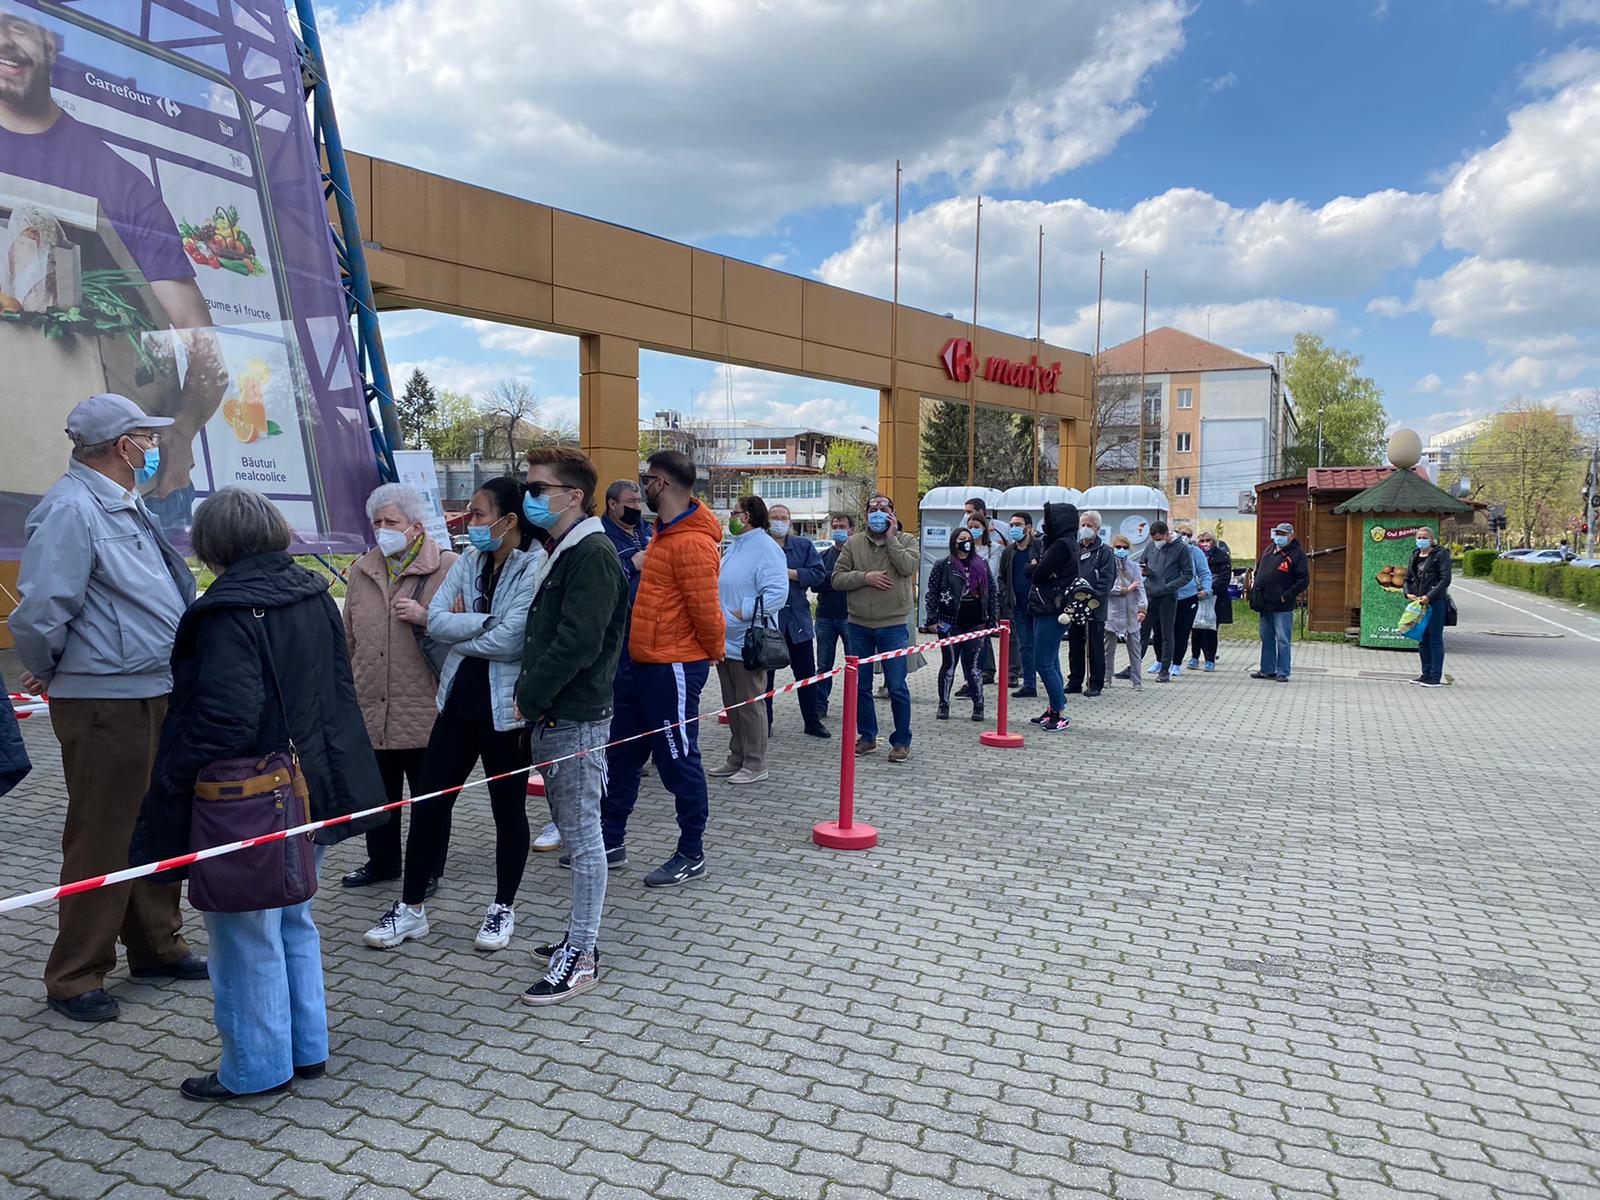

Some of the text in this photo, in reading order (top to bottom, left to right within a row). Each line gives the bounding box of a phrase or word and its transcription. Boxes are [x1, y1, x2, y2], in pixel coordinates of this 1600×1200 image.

[85, 71, 152, 106] Carrefour
[244, 305, 272, 320] fructe
[983, 354, 1063, 394] market
[241, 456, 276, 469] Băuturi
[235, 470, 287, 482] nealcoolice
